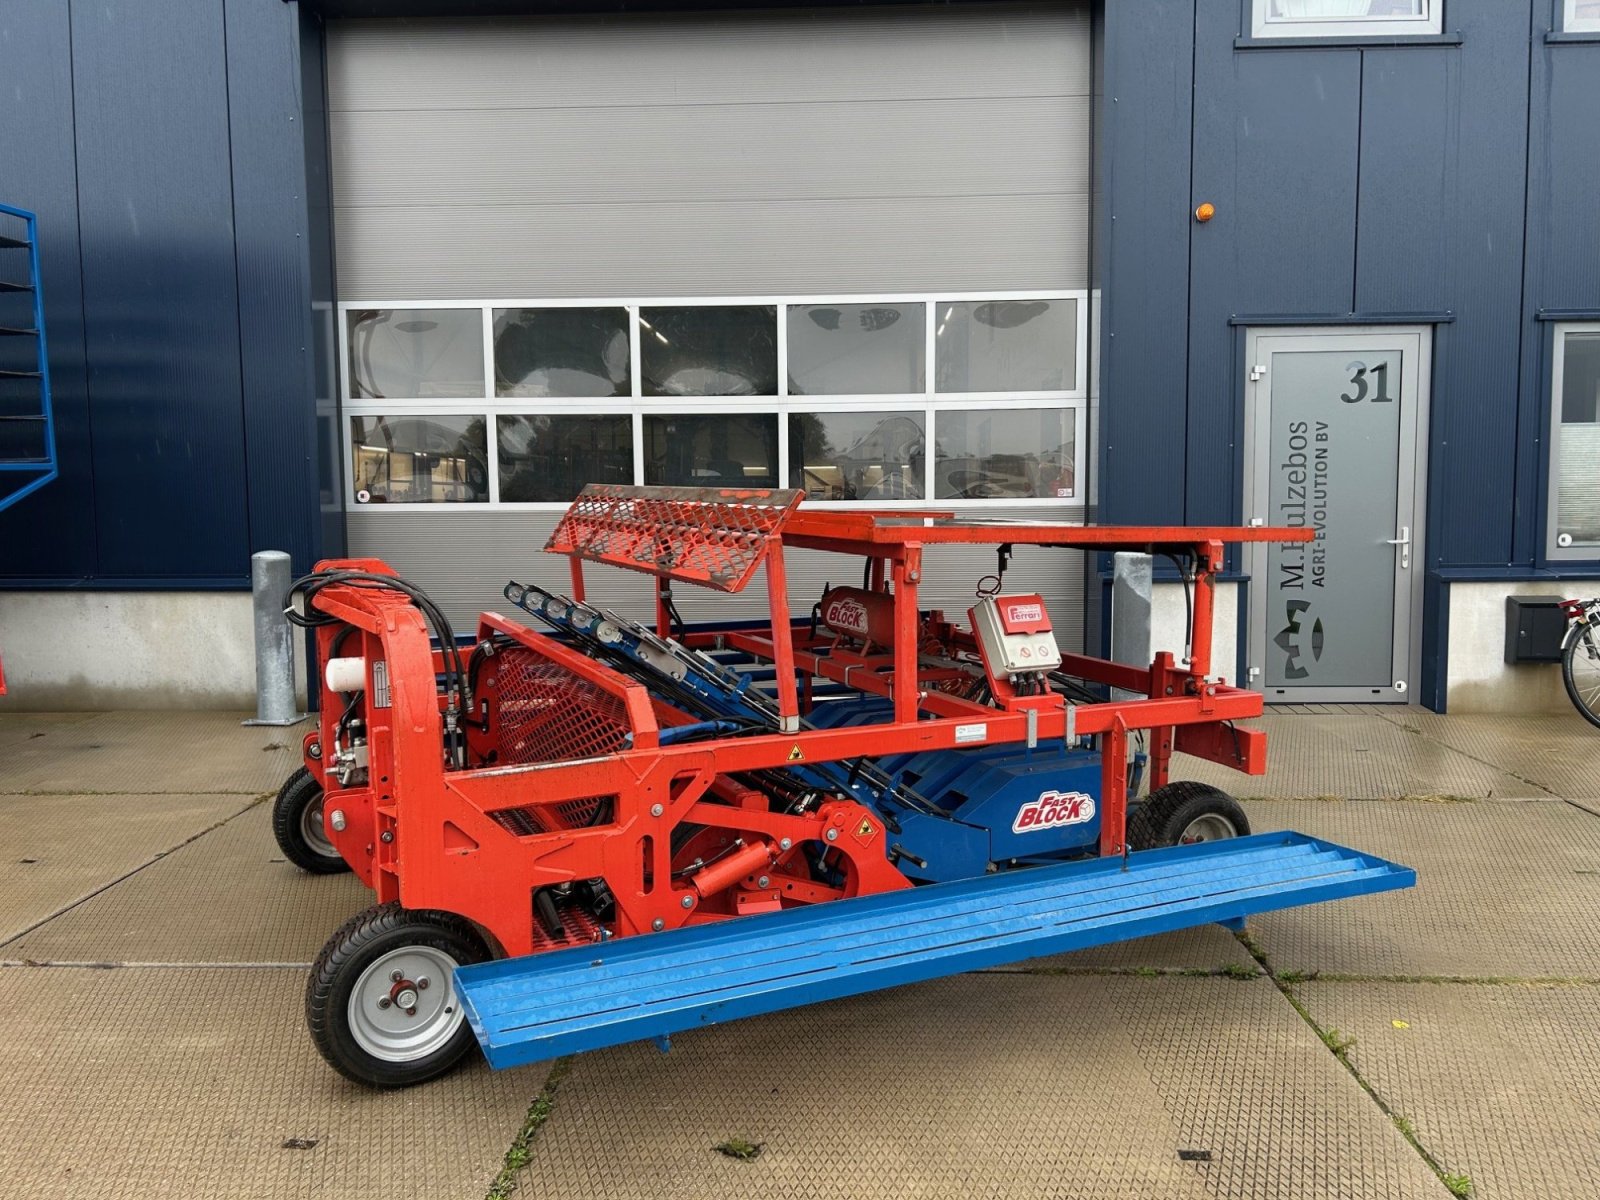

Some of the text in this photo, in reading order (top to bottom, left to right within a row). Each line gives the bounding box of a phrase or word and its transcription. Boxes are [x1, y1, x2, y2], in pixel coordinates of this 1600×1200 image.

[1340, 360, 1392, 403] 31
[1311, 421, 1328, 588] AGRI-EVOLUTION BV
[829, 606, 863, 627] BLOCK
[1009, 607, 1040, 620] Ferrari
[1017, 799, 1085, 828] BLOCK
